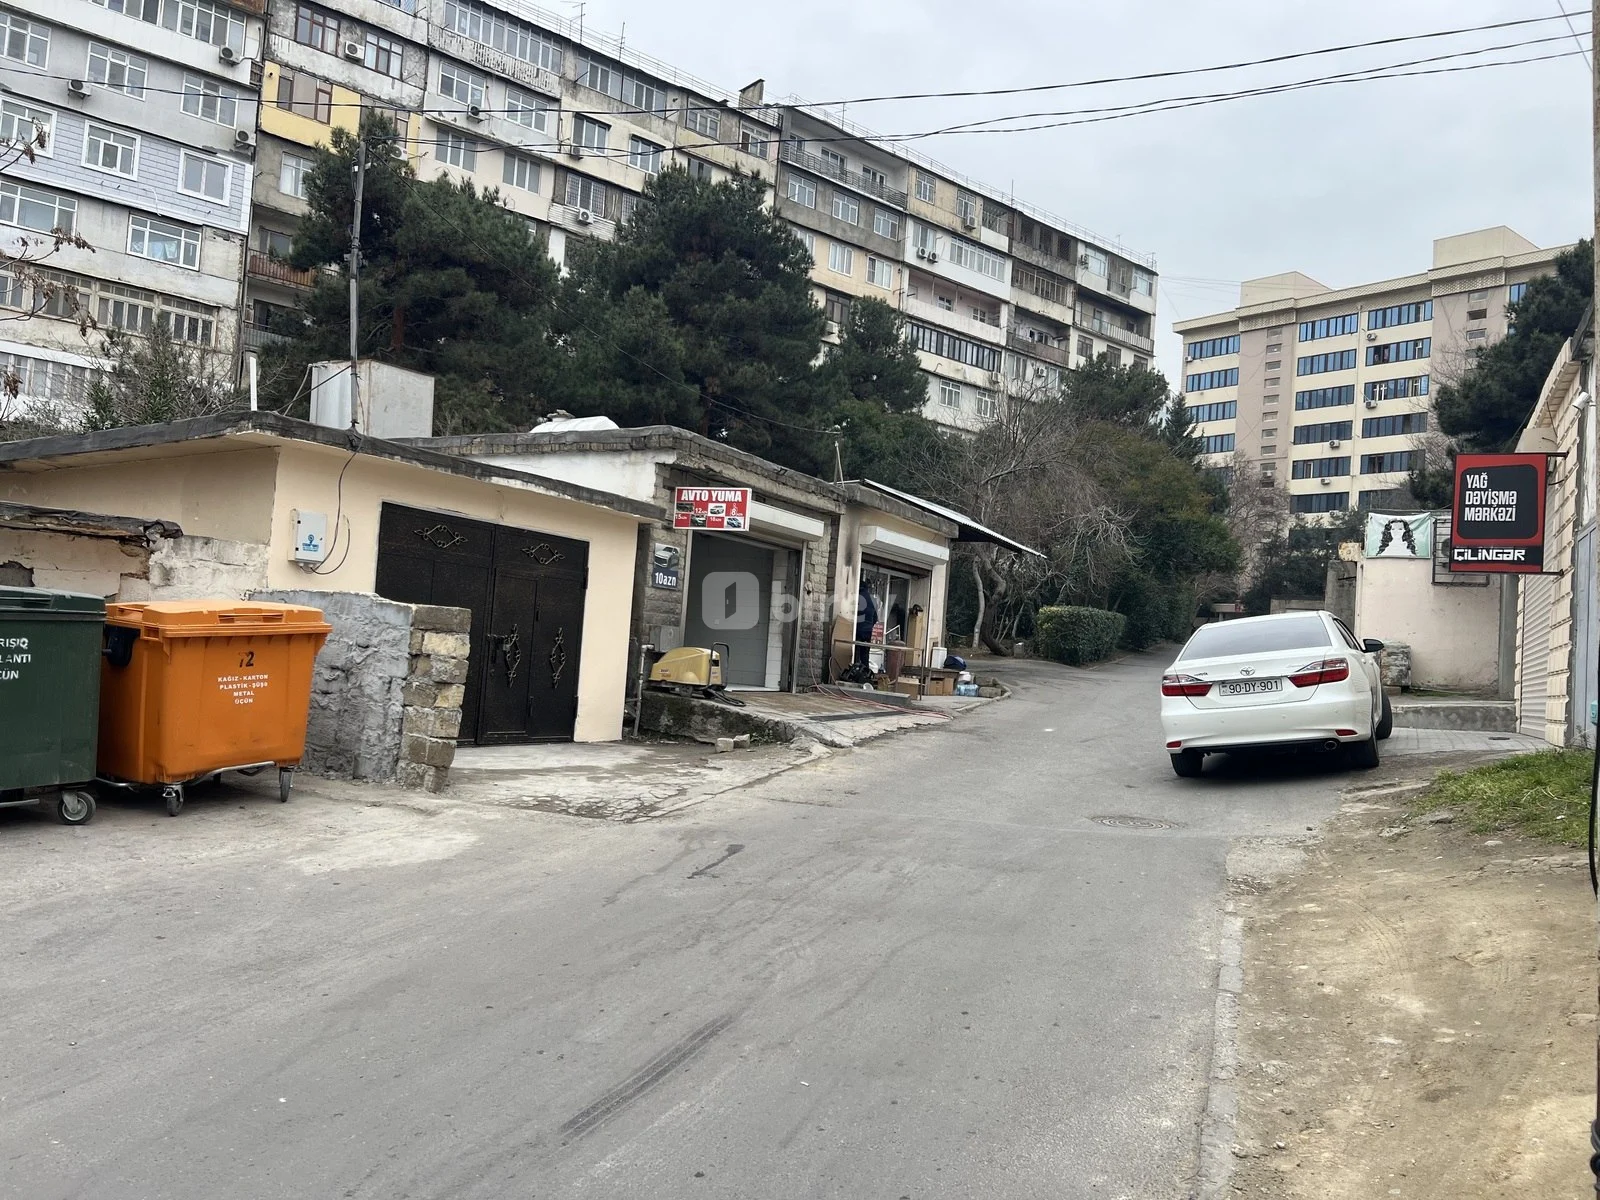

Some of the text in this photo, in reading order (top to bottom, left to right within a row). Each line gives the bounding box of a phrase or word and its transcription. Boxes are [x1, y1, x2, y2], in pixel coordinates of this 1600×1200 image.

[1466, 472, 1488, 488] YAĞ
[681, 490, 742, 502] AVTO YUMA
[655, 571, 677, 587] 10azn
